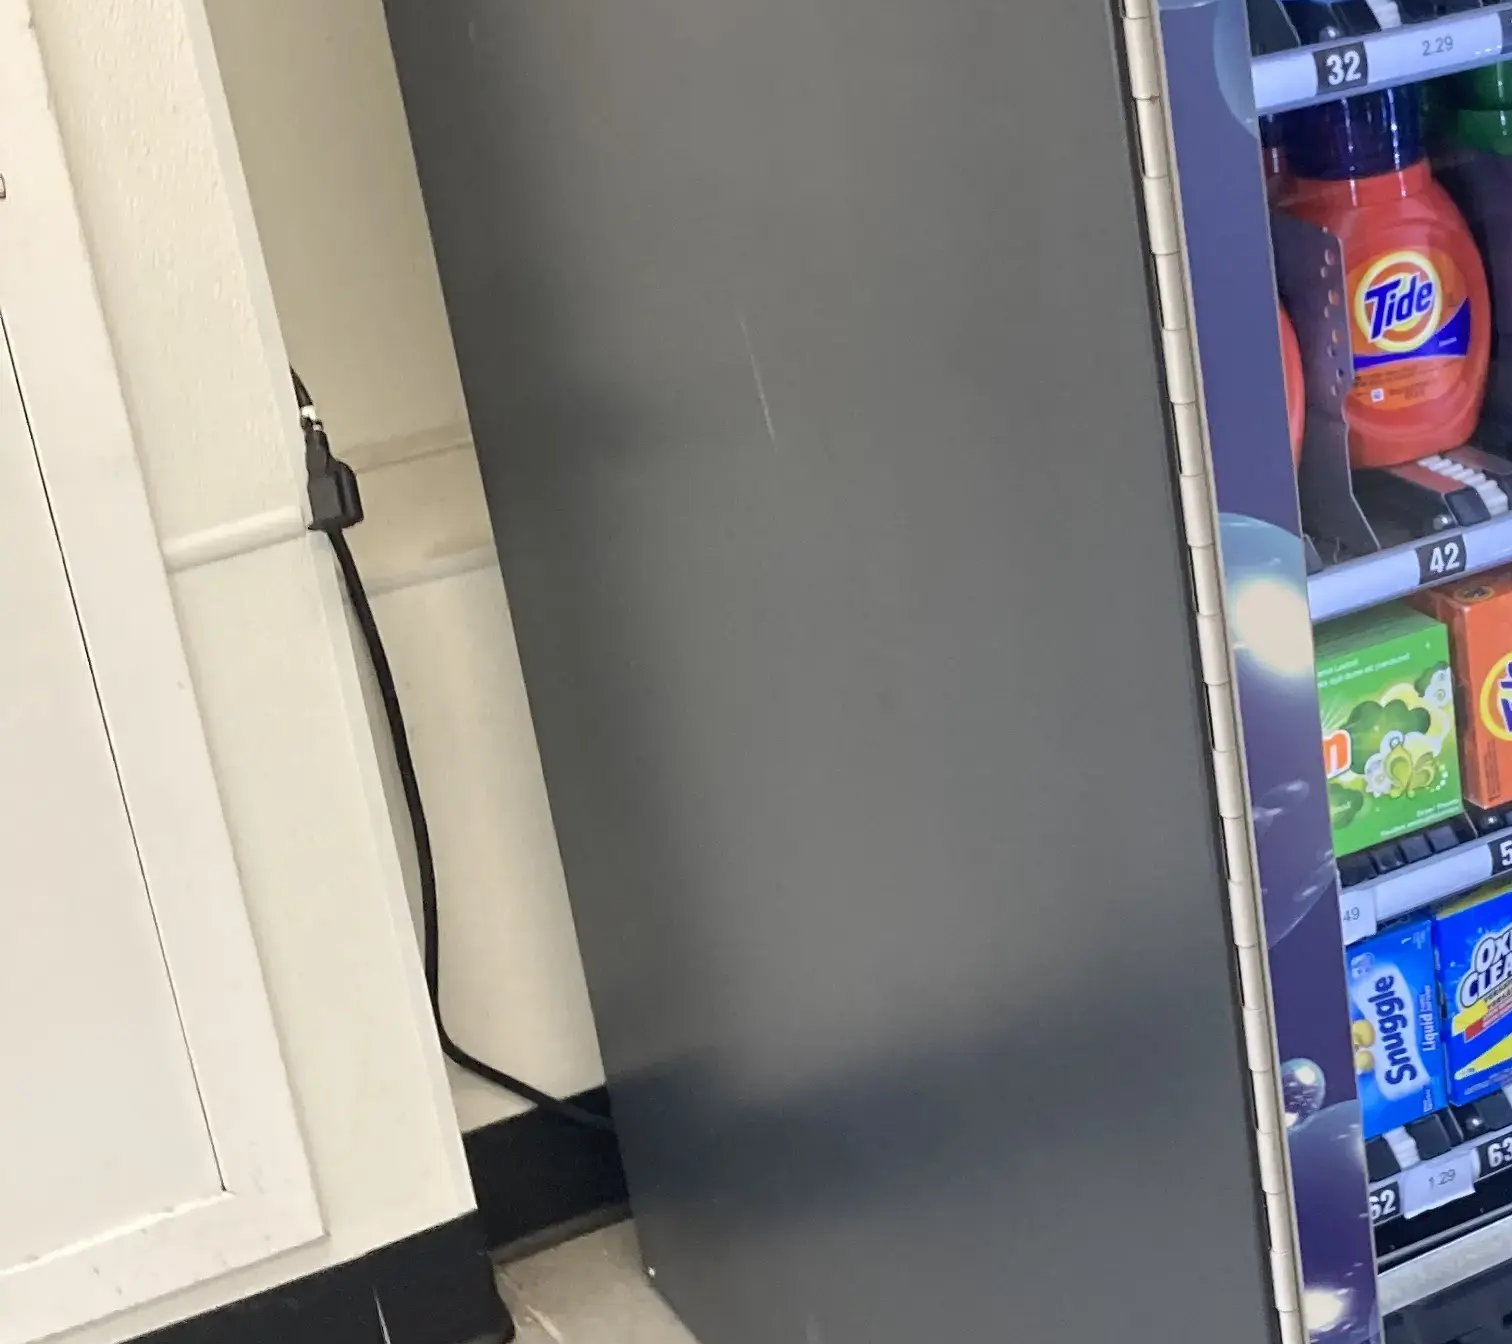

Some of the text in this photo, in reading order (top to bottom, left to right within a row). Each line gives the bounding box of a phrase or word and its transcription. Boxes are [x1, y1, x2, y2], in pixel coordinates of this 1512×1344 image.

[1422, 36, 1453, 56] 2.29
[1326, 50, 1361, 86] 32
[1364, 275, 1434, 339] Tide
[1430, 542, 1460, 575] 42
[1343, 907, 1360, 921] 49
[1367, 975, 1417, 1085] Snuggle
[1418, 1013, 1438, 1051] Liquid
[1428, 1169, 1456, 1189] 1.29
[1368, 1189, 1396, 1220] 62
